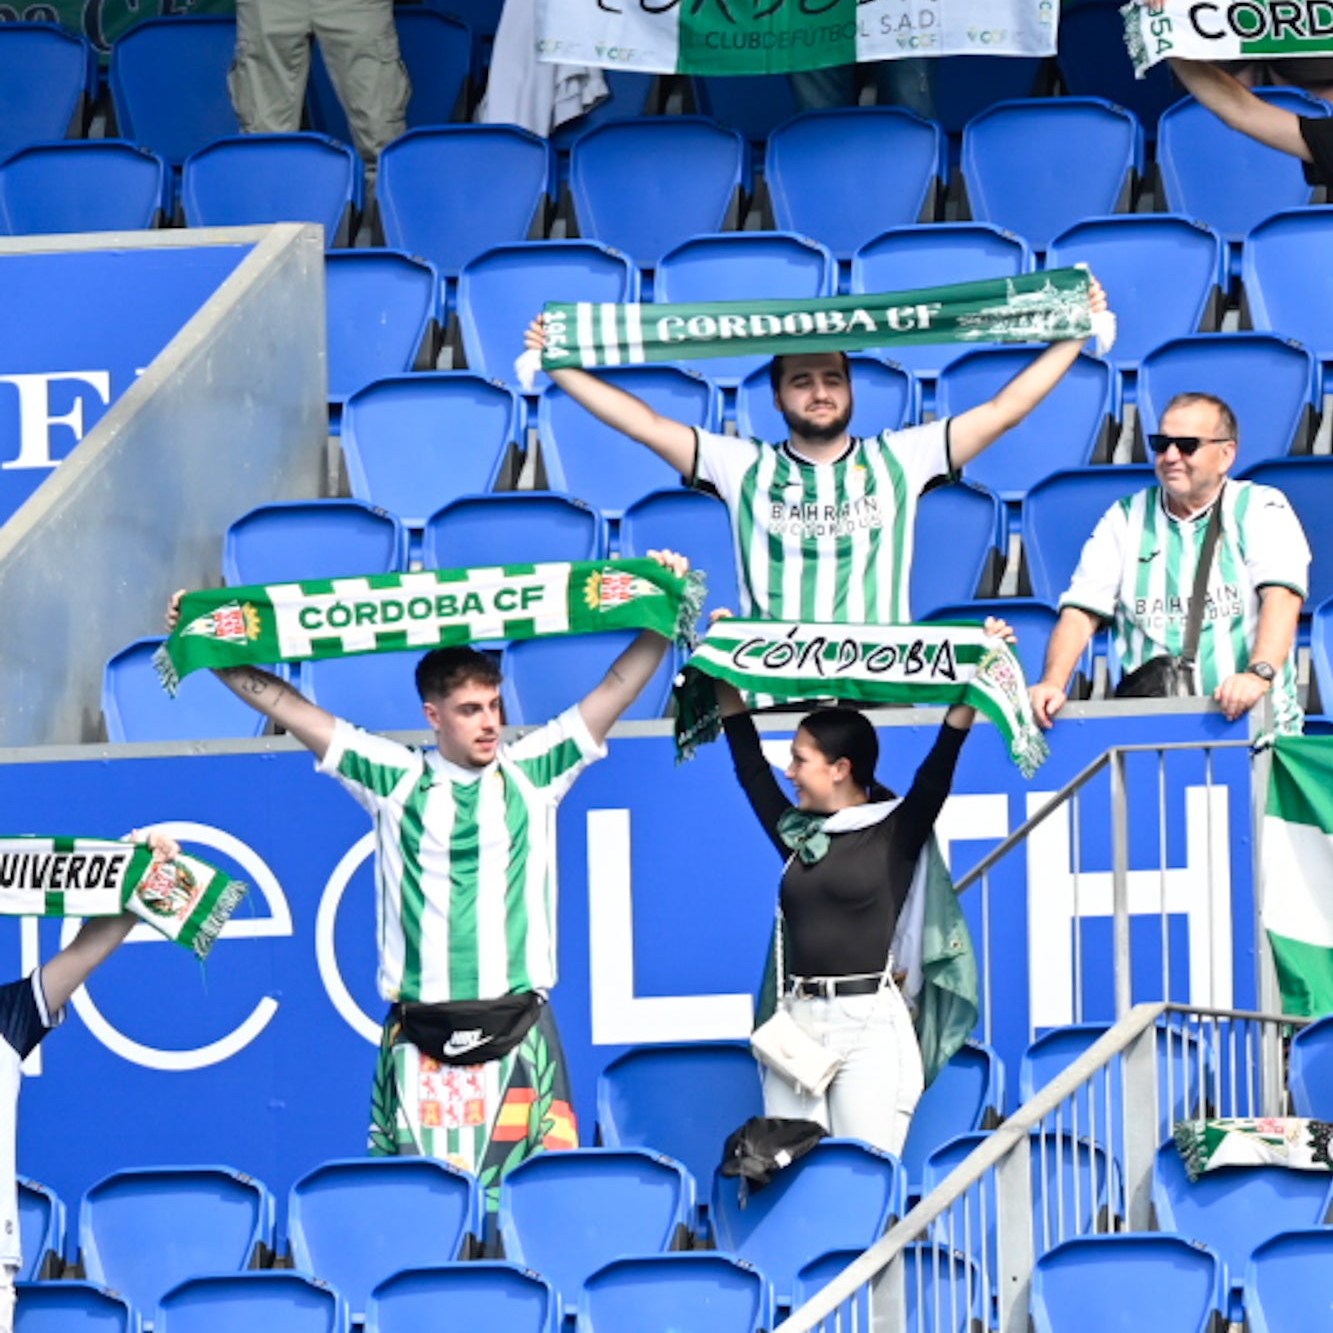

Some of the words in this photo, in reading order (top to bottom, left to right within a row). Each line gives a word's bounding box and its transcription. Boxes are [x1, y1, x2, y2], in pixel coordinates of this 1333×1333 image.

[885, 302, 941, 331] CF
[772, 496, 877, 521] BAHRAIN
[298, 592, 488, 632] CÓRDOBA
[492, 585, 546, 612] CF
[1135, 583, 1238, 615] BAHAIN
[732, 627, 959, 681] CÓRDOBA
